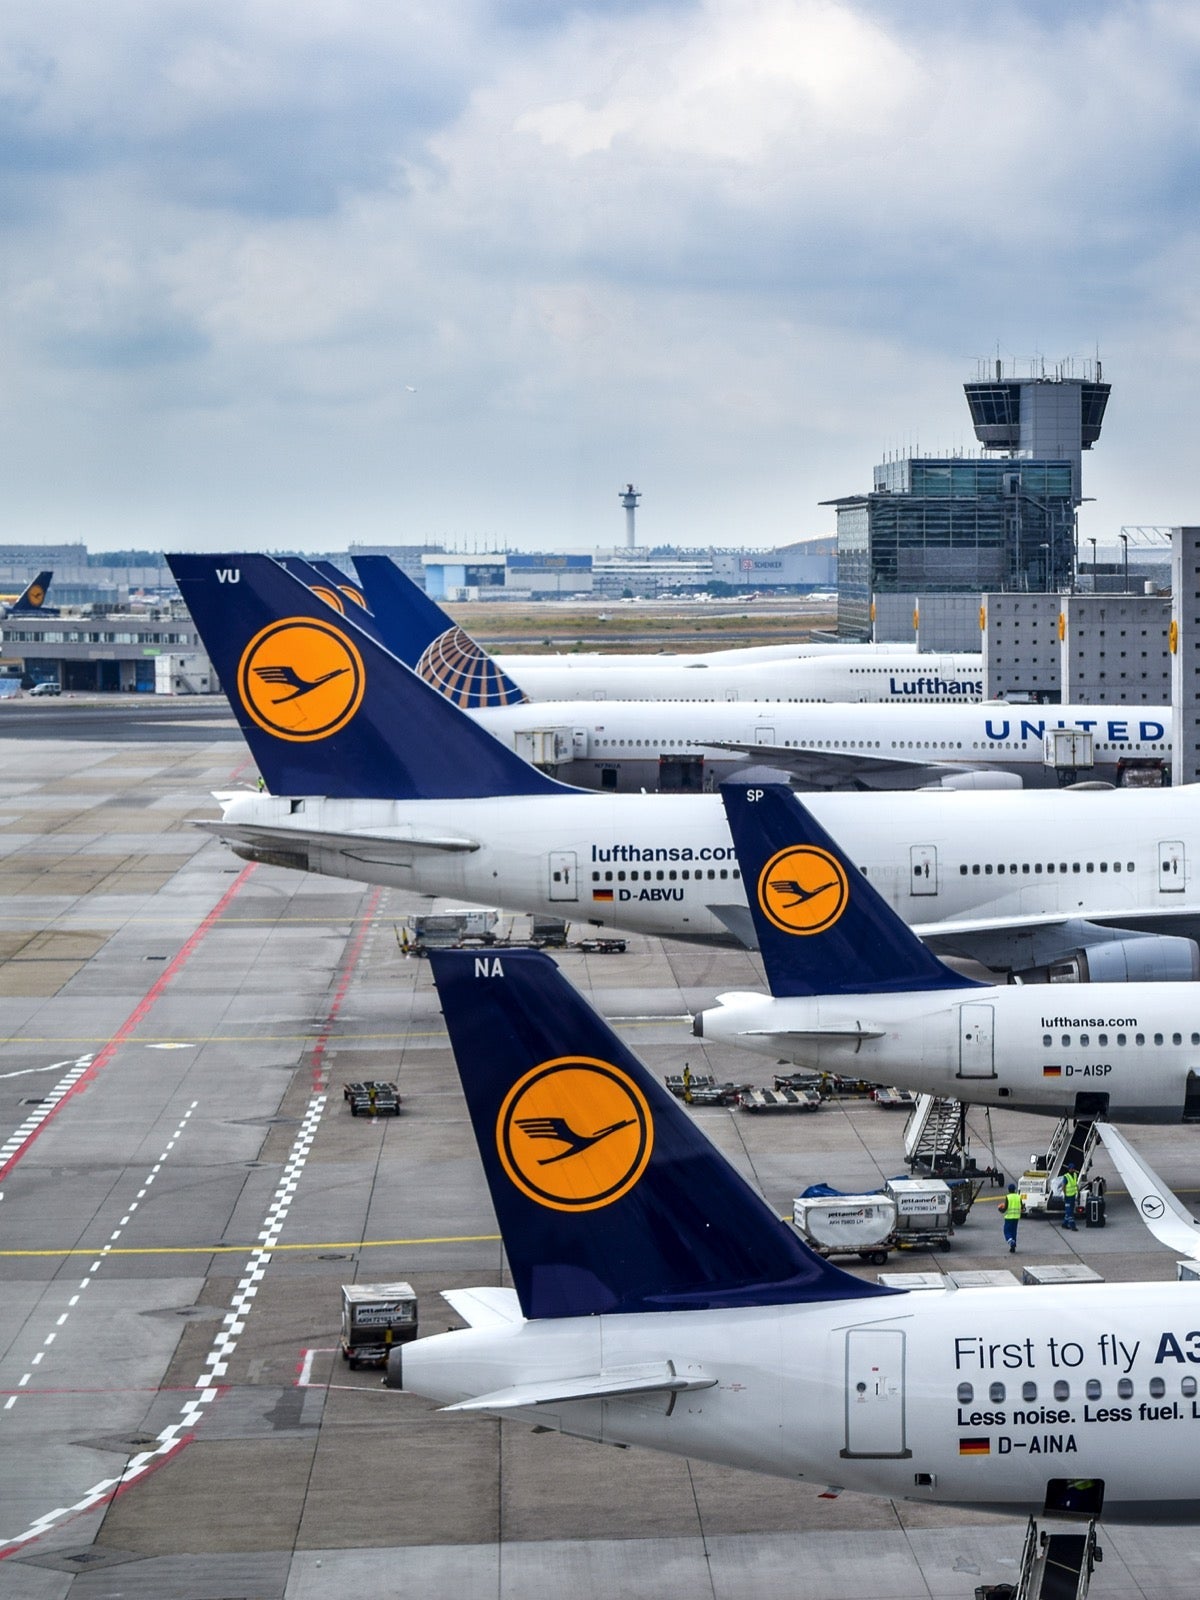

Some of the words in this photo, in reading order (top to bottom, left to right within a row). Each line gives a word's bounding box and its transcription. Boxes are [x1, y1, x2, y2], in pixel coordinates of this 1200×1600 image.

[215, 569, 240, 583] VU
[889, 677, 983, 695] Lufthans
[746, 789, 764, 802] SP
[618, 888, 685, 901] D-ABVU
[475, 957, 504, 978] NA
[1041, 1016, 1138, 1027] lufthansa.com
[1065, 1064, 1112, 1077] D-AISP
[954, 1336, 1036, 1370] First
[1047, 1339, 1084, 1368] to
[1098, 1334, 1141, 1373] fly
[957, 1408, 1007, 1426] Less
[1012, 1405, 1076, 1425] noise.
[1084, 1404, 1133, 1423] Less
[1138, 1401, 1185, 1421] fuel.
[998, 1435, 1078, 1454] D-AINA
